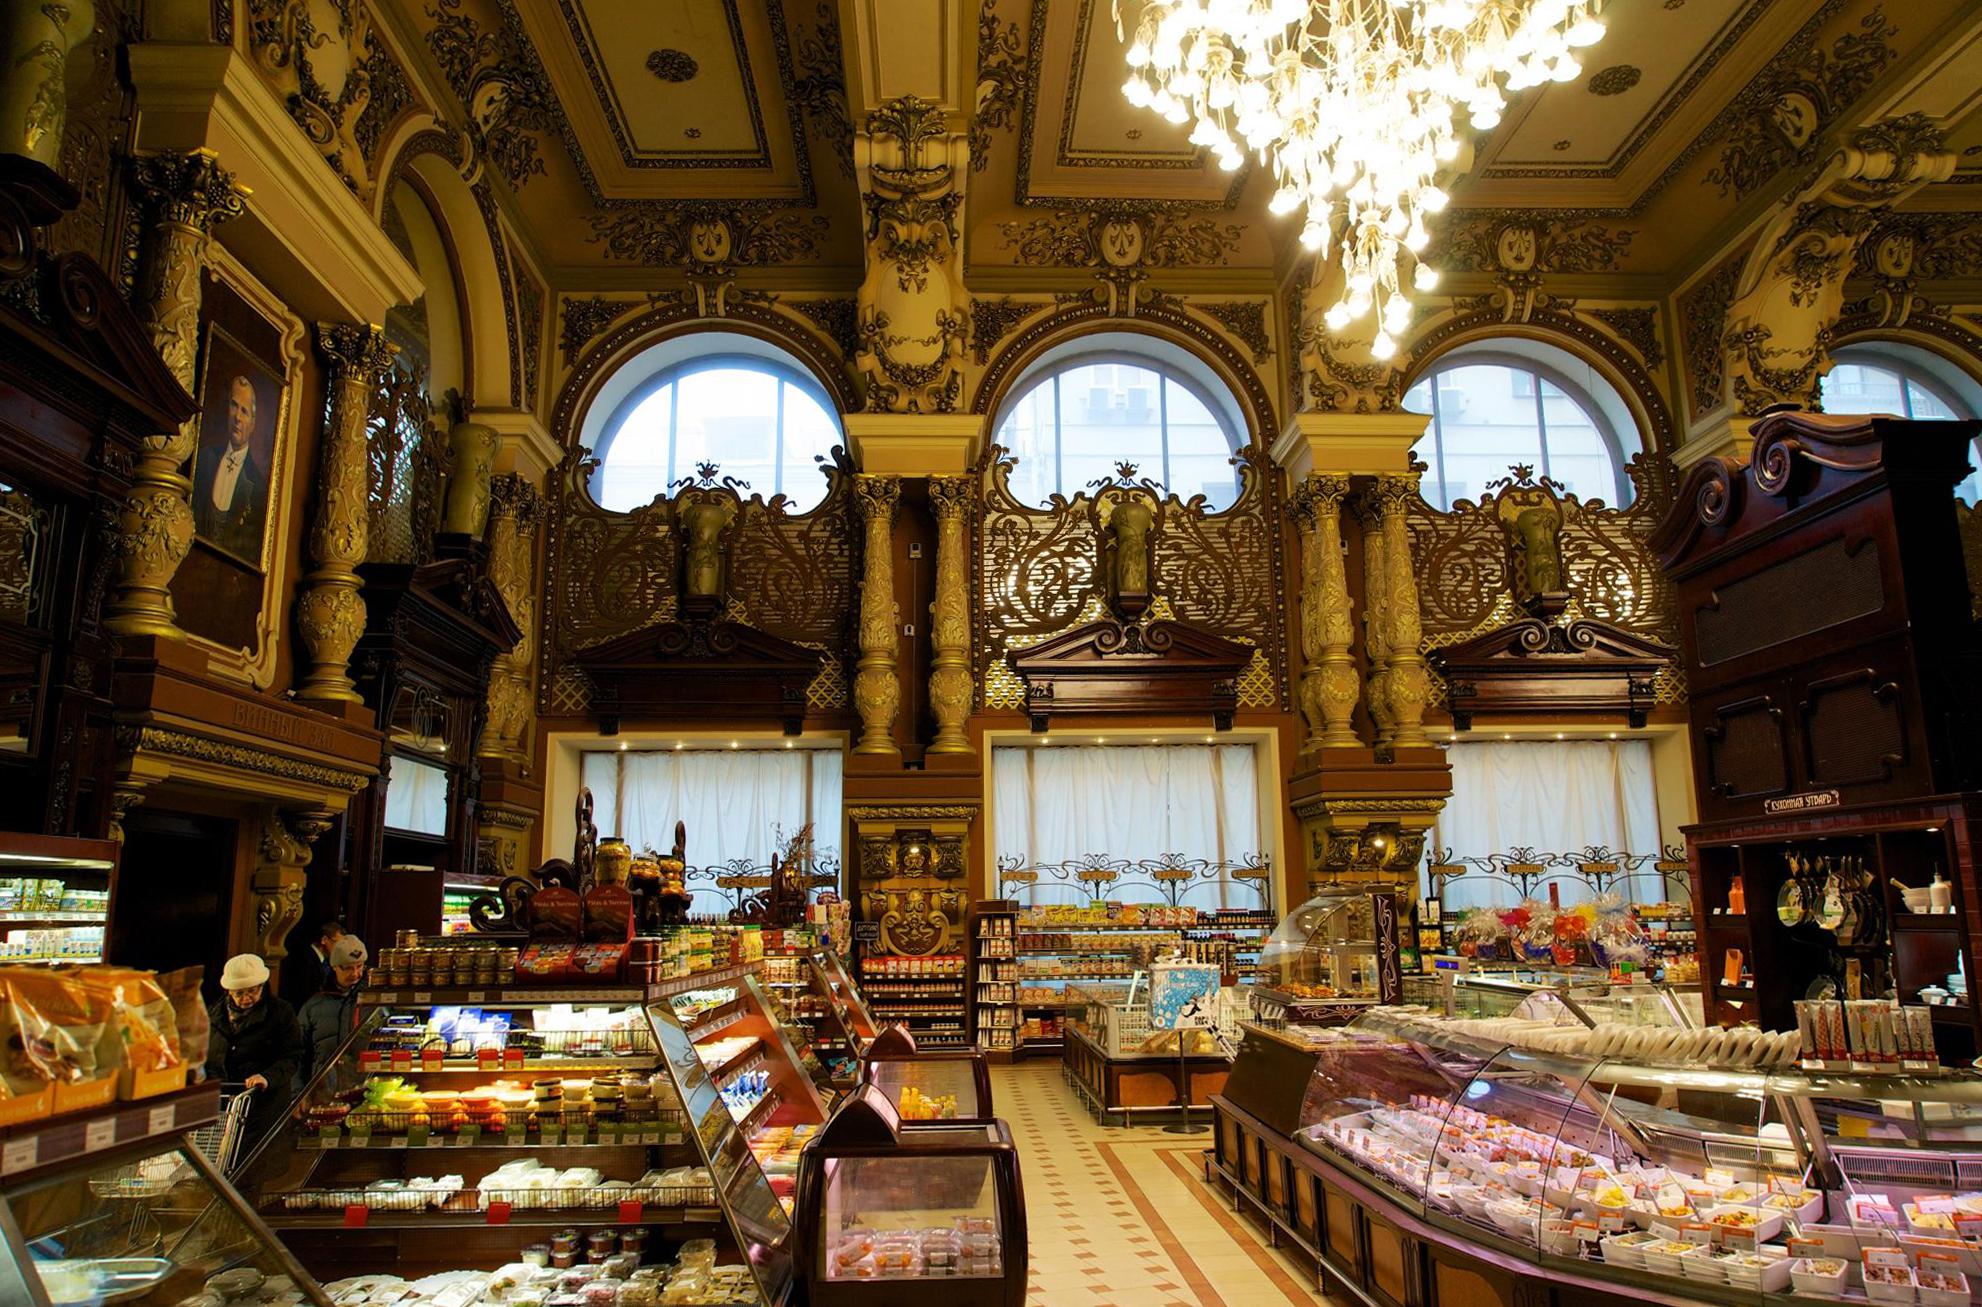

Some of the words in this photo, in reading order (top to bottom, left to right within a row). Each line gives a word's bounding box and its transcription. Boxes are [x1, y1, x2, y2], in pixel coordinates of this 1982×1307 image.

[233, 703, 303, 740] ВИННЫЙ
[1771, 796, 1804, 811] КУХОННАЯ
[1805, 793, 1832, 807] УТВАРЬ
